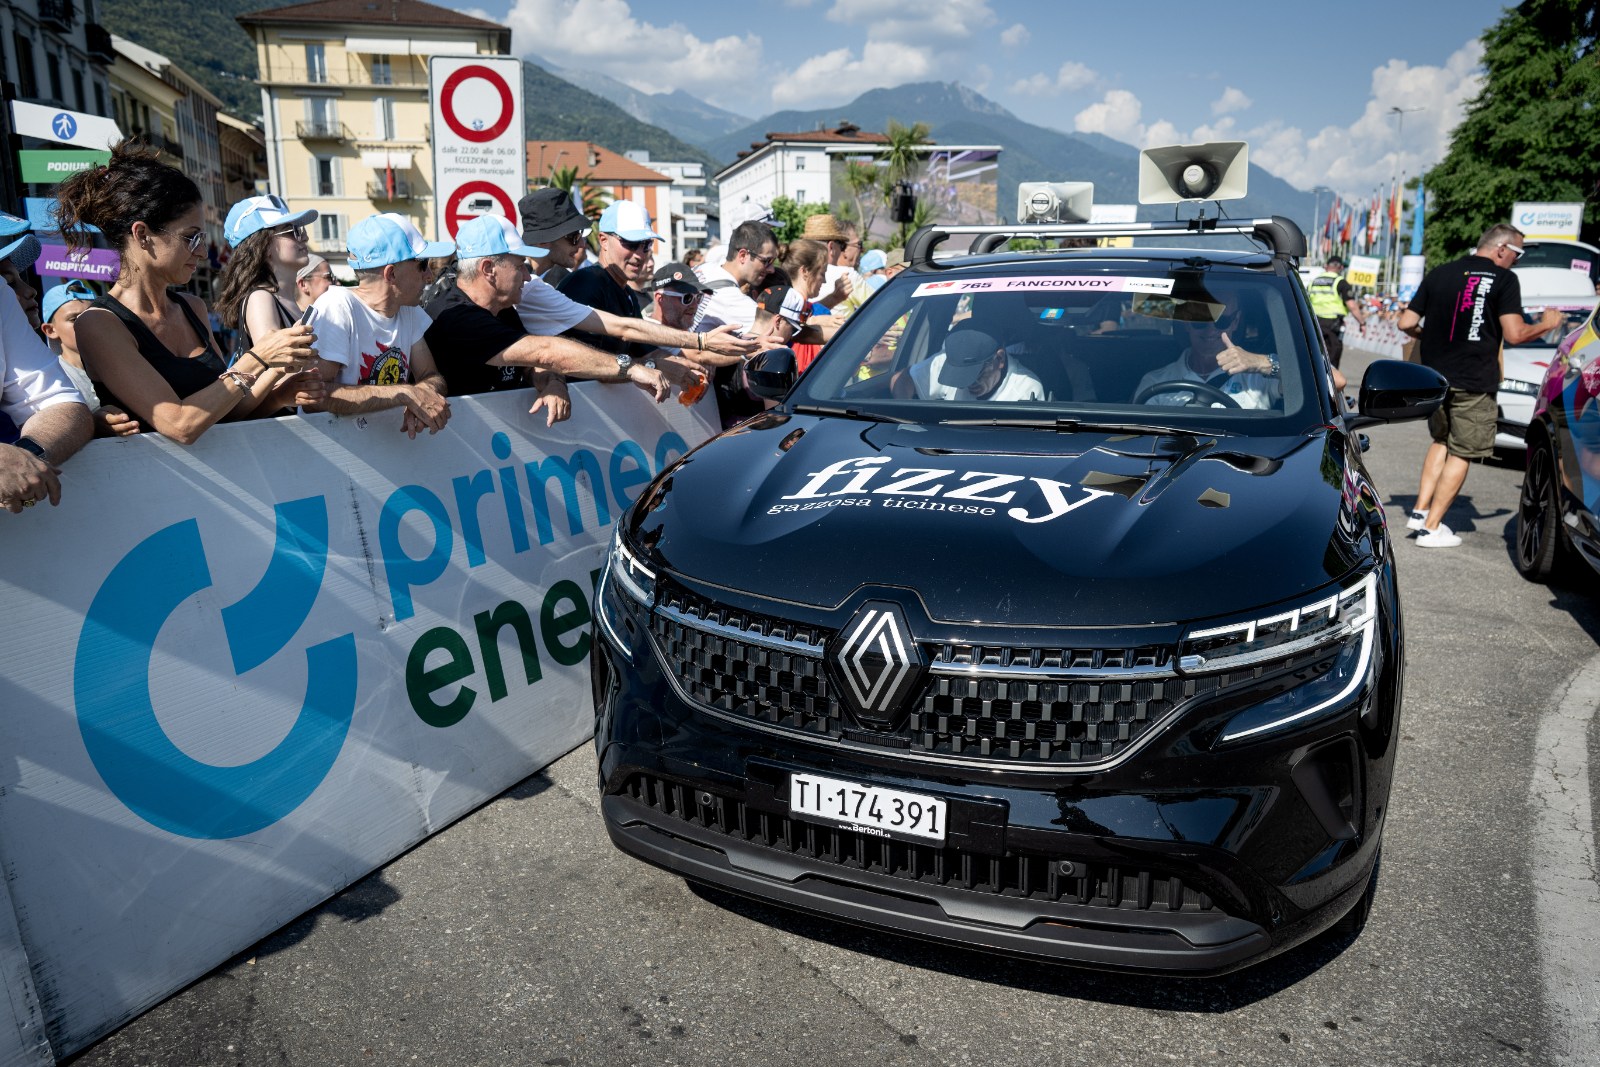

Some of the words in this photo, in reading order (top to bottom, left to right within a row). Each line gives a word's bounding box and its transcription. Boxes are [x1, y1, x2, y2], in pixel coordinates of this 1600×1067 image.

[441, 146, 458, 154] dalle
[461, 147, 479, 155] 22.00
[482, 147, 494, 155] alle
[497, 148, 517, 156] 06.00
[455, 156, 489, 164] ECCEZIONI
[47, 162, 90, 172] PODIUM
[443, 167, 477, 175] permesso
[479, 168, 515, 176] municipale
[1537, 211, 1572, 220] primeo
[1536, 219, 1573, 229] energie
[70, 252, 89, 263] VIP
[45, 260, 115, 275] HOSPITALITY
[1353, 272, 1372, 284] 100
[961, 281, 993, 290] 765
[1006, 279, 1113, 289] FANCONVOY
[1477, 276, 1494, 297] Mir
[1468, 296, 1486, 342] mached
[780, 456, 1115, 524] fizzy
[767, 497, 872, 516] gazzosa
[881, 496, 996, 516] ticinese
[405, 567, 602, 728] ene
